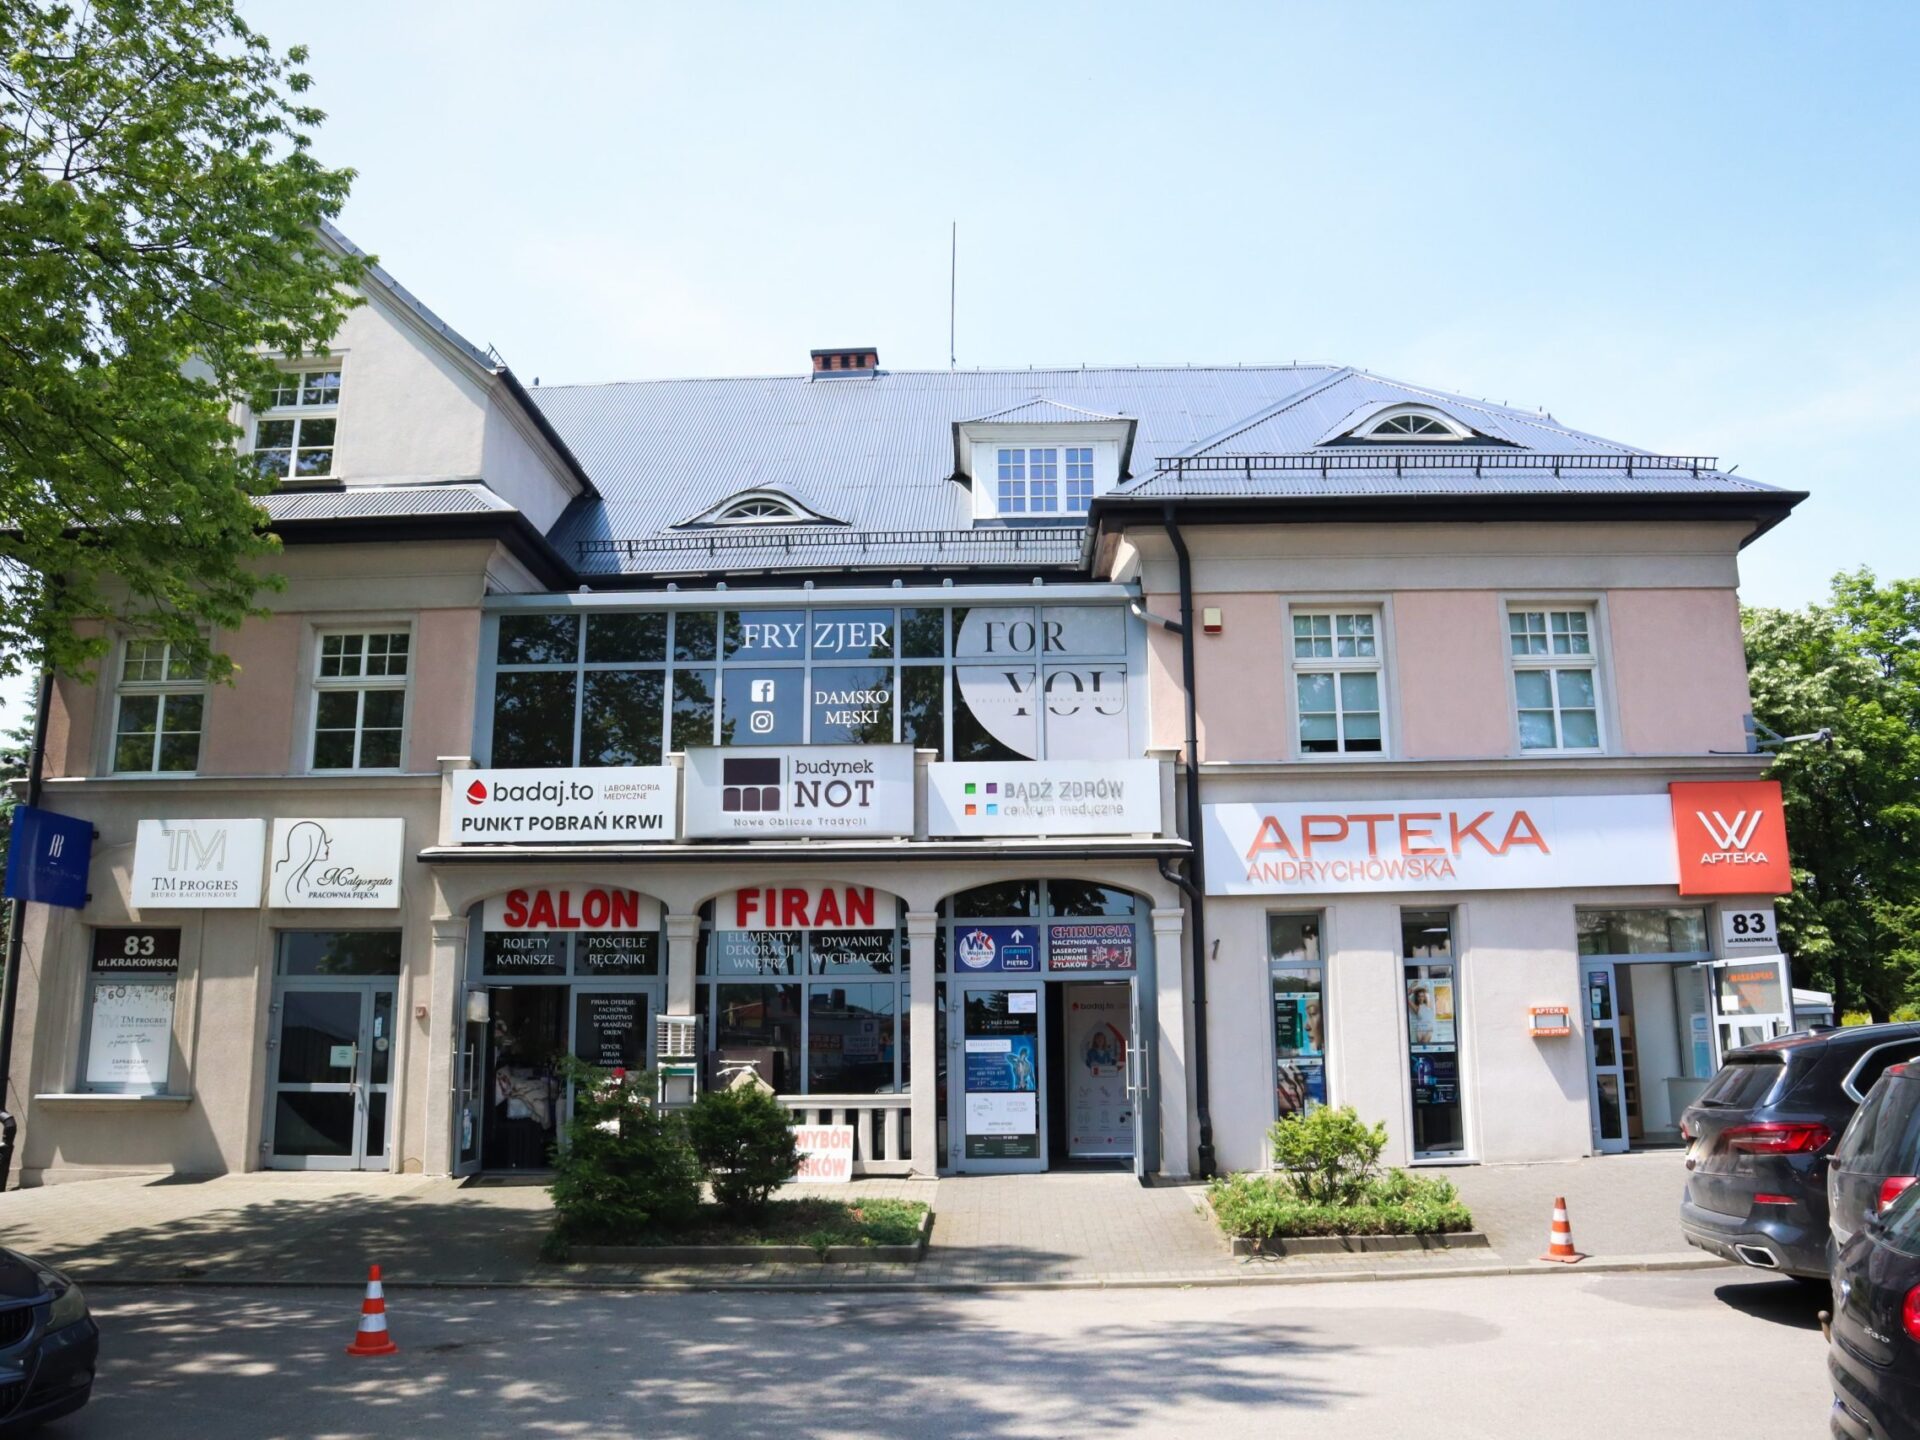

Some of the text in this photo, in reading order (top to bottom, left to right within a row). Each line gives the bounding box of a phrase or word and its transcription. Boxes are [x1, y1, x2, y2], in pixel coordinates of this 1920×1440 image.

[984, 621, 1066, 653] FOR
[815, 690, 889, 705] DAMSKO
[1001, 670, 1127, 716] YOU
[825, 711, 878, 728] MĘSKI
[796, 759, 874, 776] budynek
[493, 780, 593, 807] badaj.to
[604, 784, 660, 792] LABORATORIA
[794, 780, 874, 807] NOT
[1004, 778, 1124, 807] BĄDŹ ZDRÓW
[1004, 803, 1124, 817] centrum medyczne
[462, 811, 663, 831] PUNKT POBRAŃ KRWI
[733, 816, 867, 827] Nowe Oblicze Tradycji
[1246, 810, 1551, 858] APTEKA
[1700, 852, 1768, 864] APTEKA
[1246, 857, 1456, 881] ANDRYCHOWSKA
[152, 877, 239, 891] TM PROGRES
[352, 892, 379, 900] PIĘKNA
[504, 889, 639, 928] SALON
[737, 887, 875, 927] FIRAN
[1733, 913, 1766, 934] 83
[728, 932, 793, 942] ELEMENTY
[1052, 925, 1132, 938] CHIRURGIA
[124, 936, 154, 955] 83
[503, 938, 550, 949] ROLETY
[589, 935, 647, 948] POŚCIELE
[822, 936, 883, 947] DYWANIKI
[726, 945, 794, 957] DEKORACJI
[811, 952, 894, 964] WYCIERACZKI
[97, 958, 178, 967] ul.KRAKOWSKA
[497, 955, 555, 965] KARNISZE
[589, 954, 645, 967] RĘCZNIKI
[733, 958, 787, 971] WNĘTRZ
[796, 1127, 851, 1149] WYBÓR
